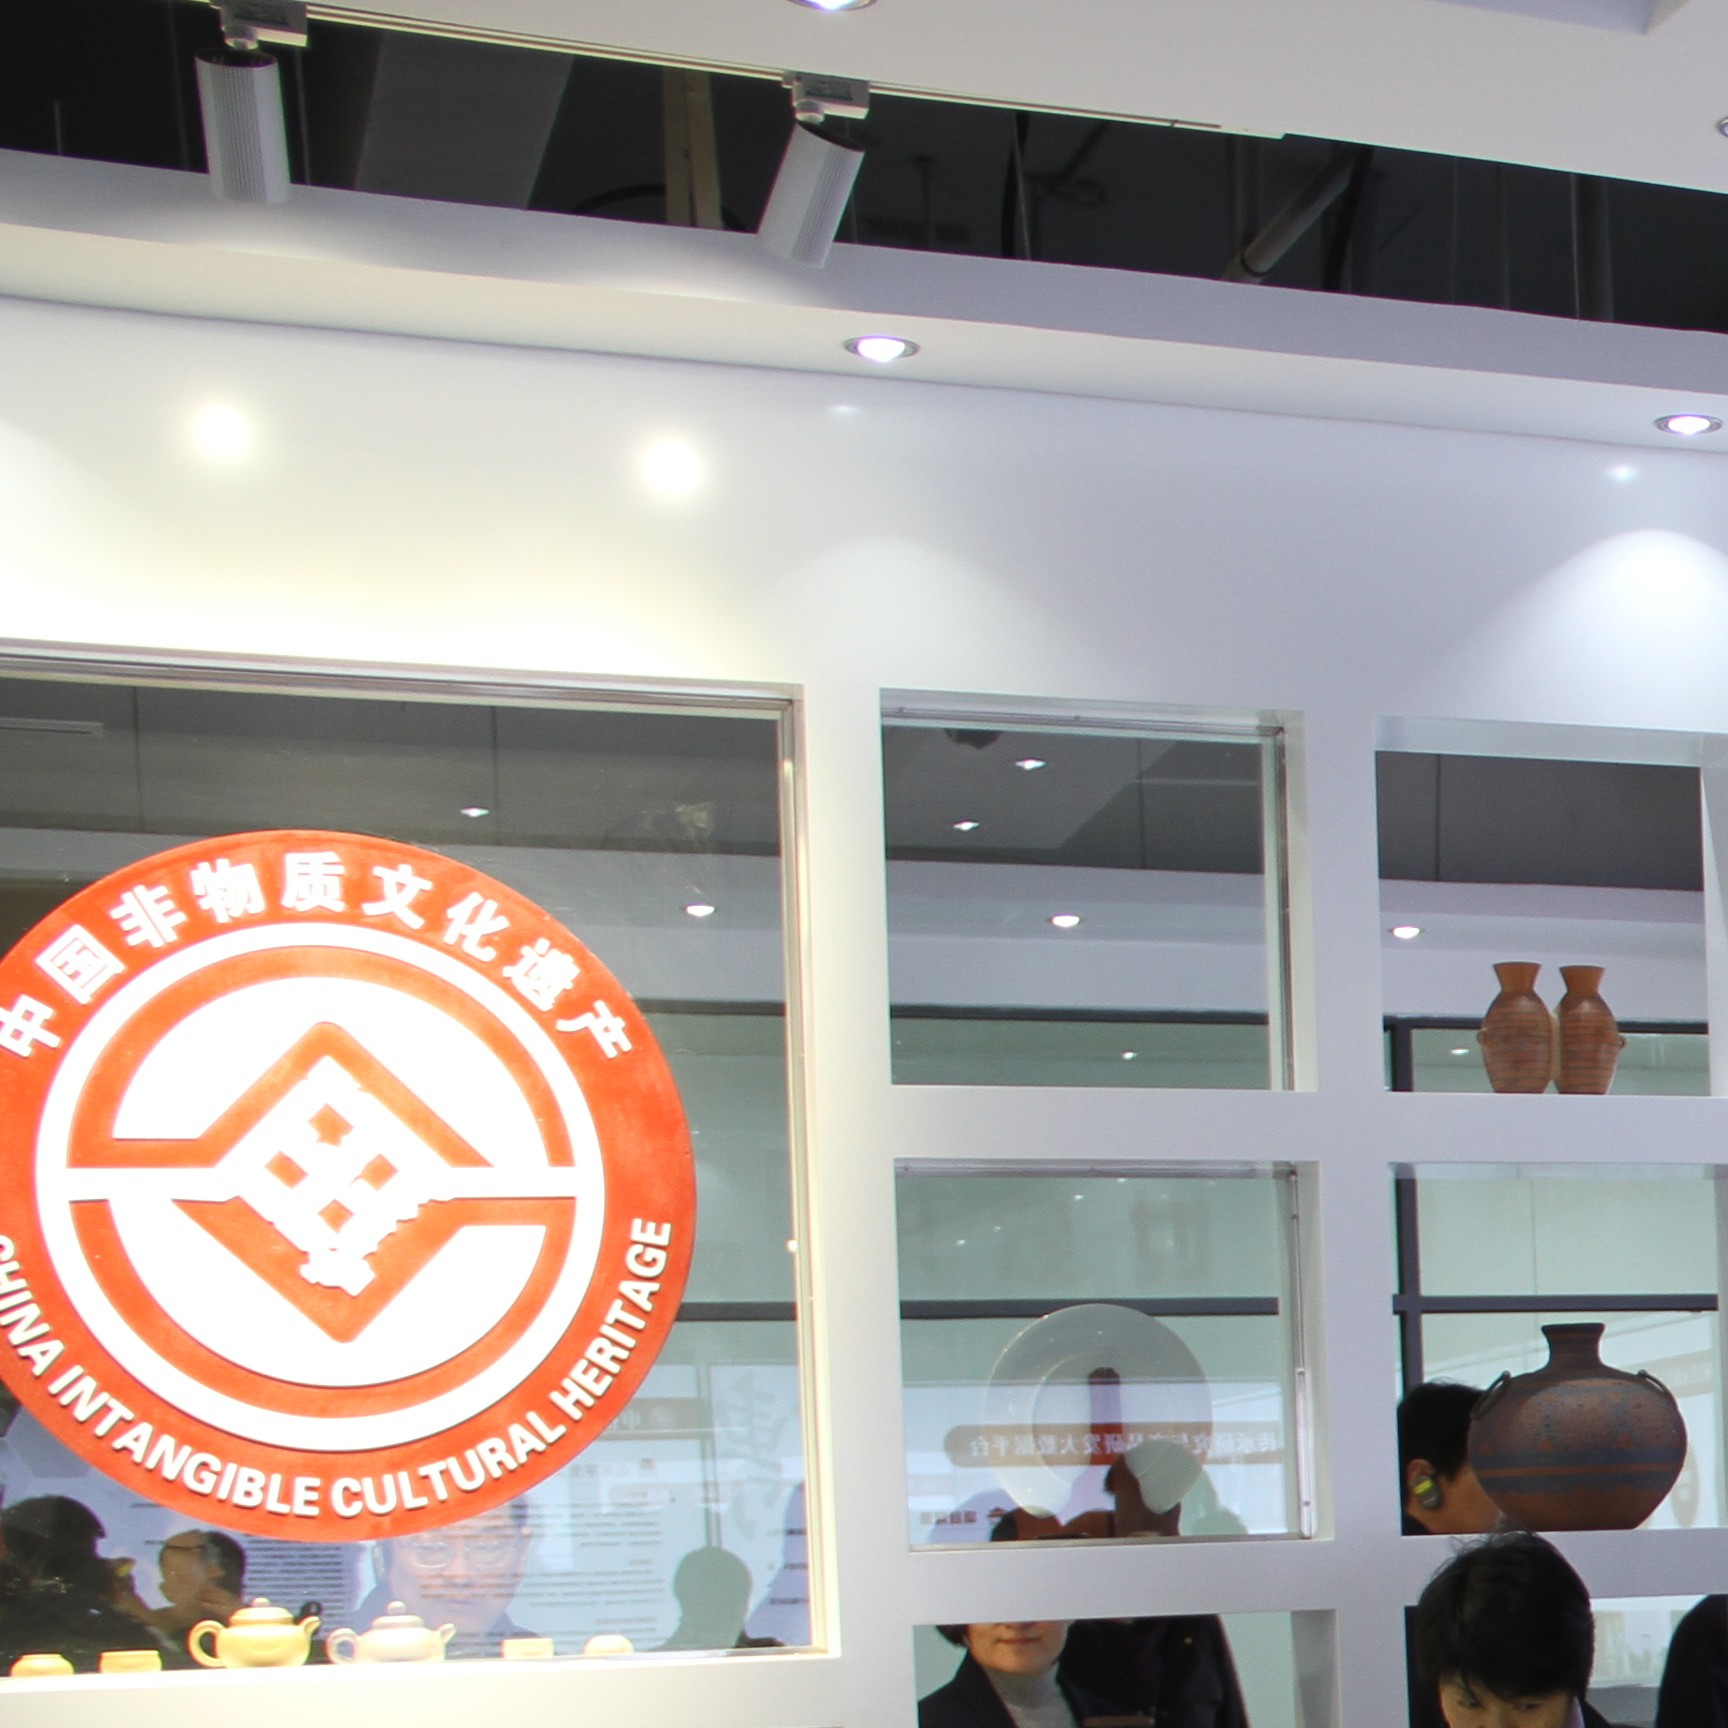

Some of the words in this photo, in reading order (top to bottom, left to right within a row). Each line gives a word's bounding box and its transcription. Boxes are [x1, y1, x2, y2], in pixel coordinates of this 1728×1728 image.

[0, 851, 632, 1058] 中国非物质文化遗产
[48, 1366, 322, 1517] INTANGIBLE
[331, 1409, 567, 1518] CULTURAL
[549, 1217, 671, 1421] HERITAGE
